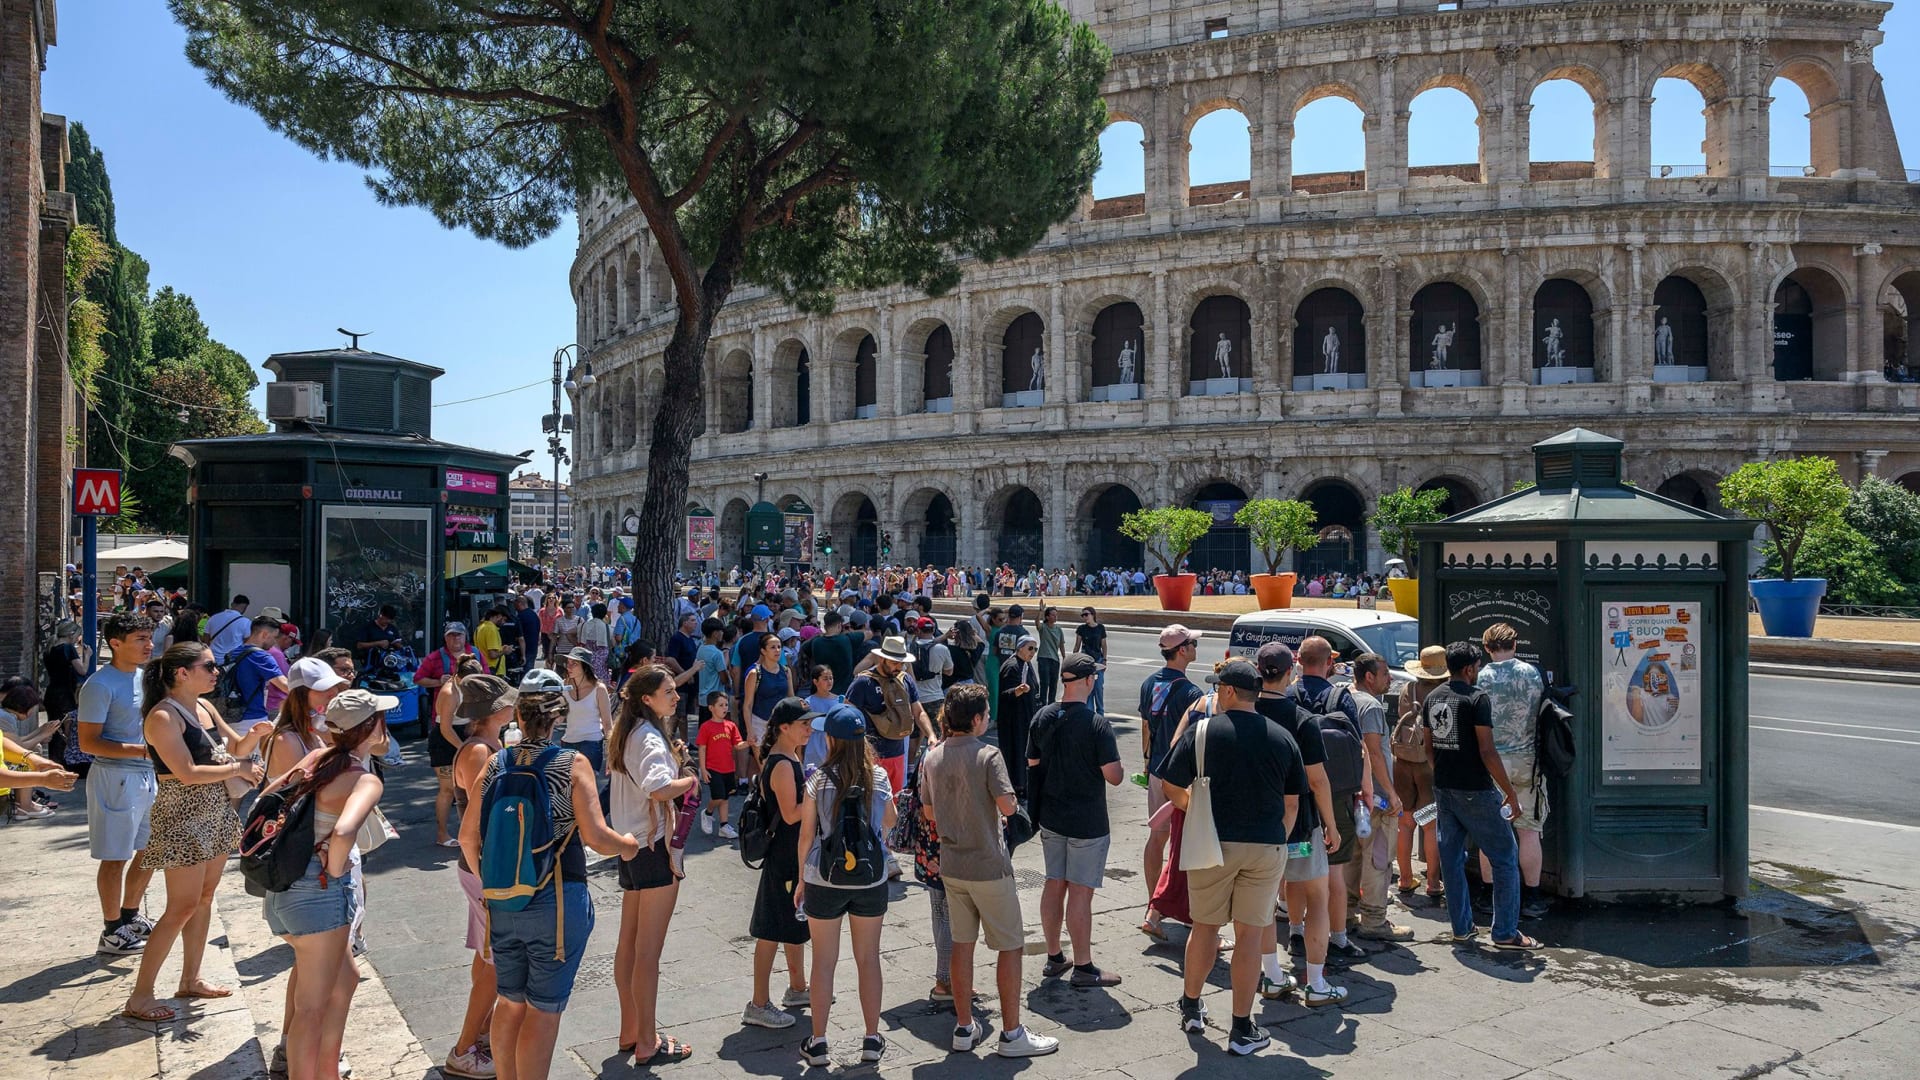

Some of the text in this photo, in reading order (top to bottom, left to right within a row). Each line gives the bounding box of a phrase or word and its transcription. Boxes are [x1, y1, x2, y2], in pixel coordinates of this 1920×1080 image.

[78, 479, 116, 507] M
[345, 488, 402, 500] GIORNALI
[473, 531, 495, 544] ATM
[472, 554, 488, 563] ATM
[1245, 632, 1271, 645] Gruppo
